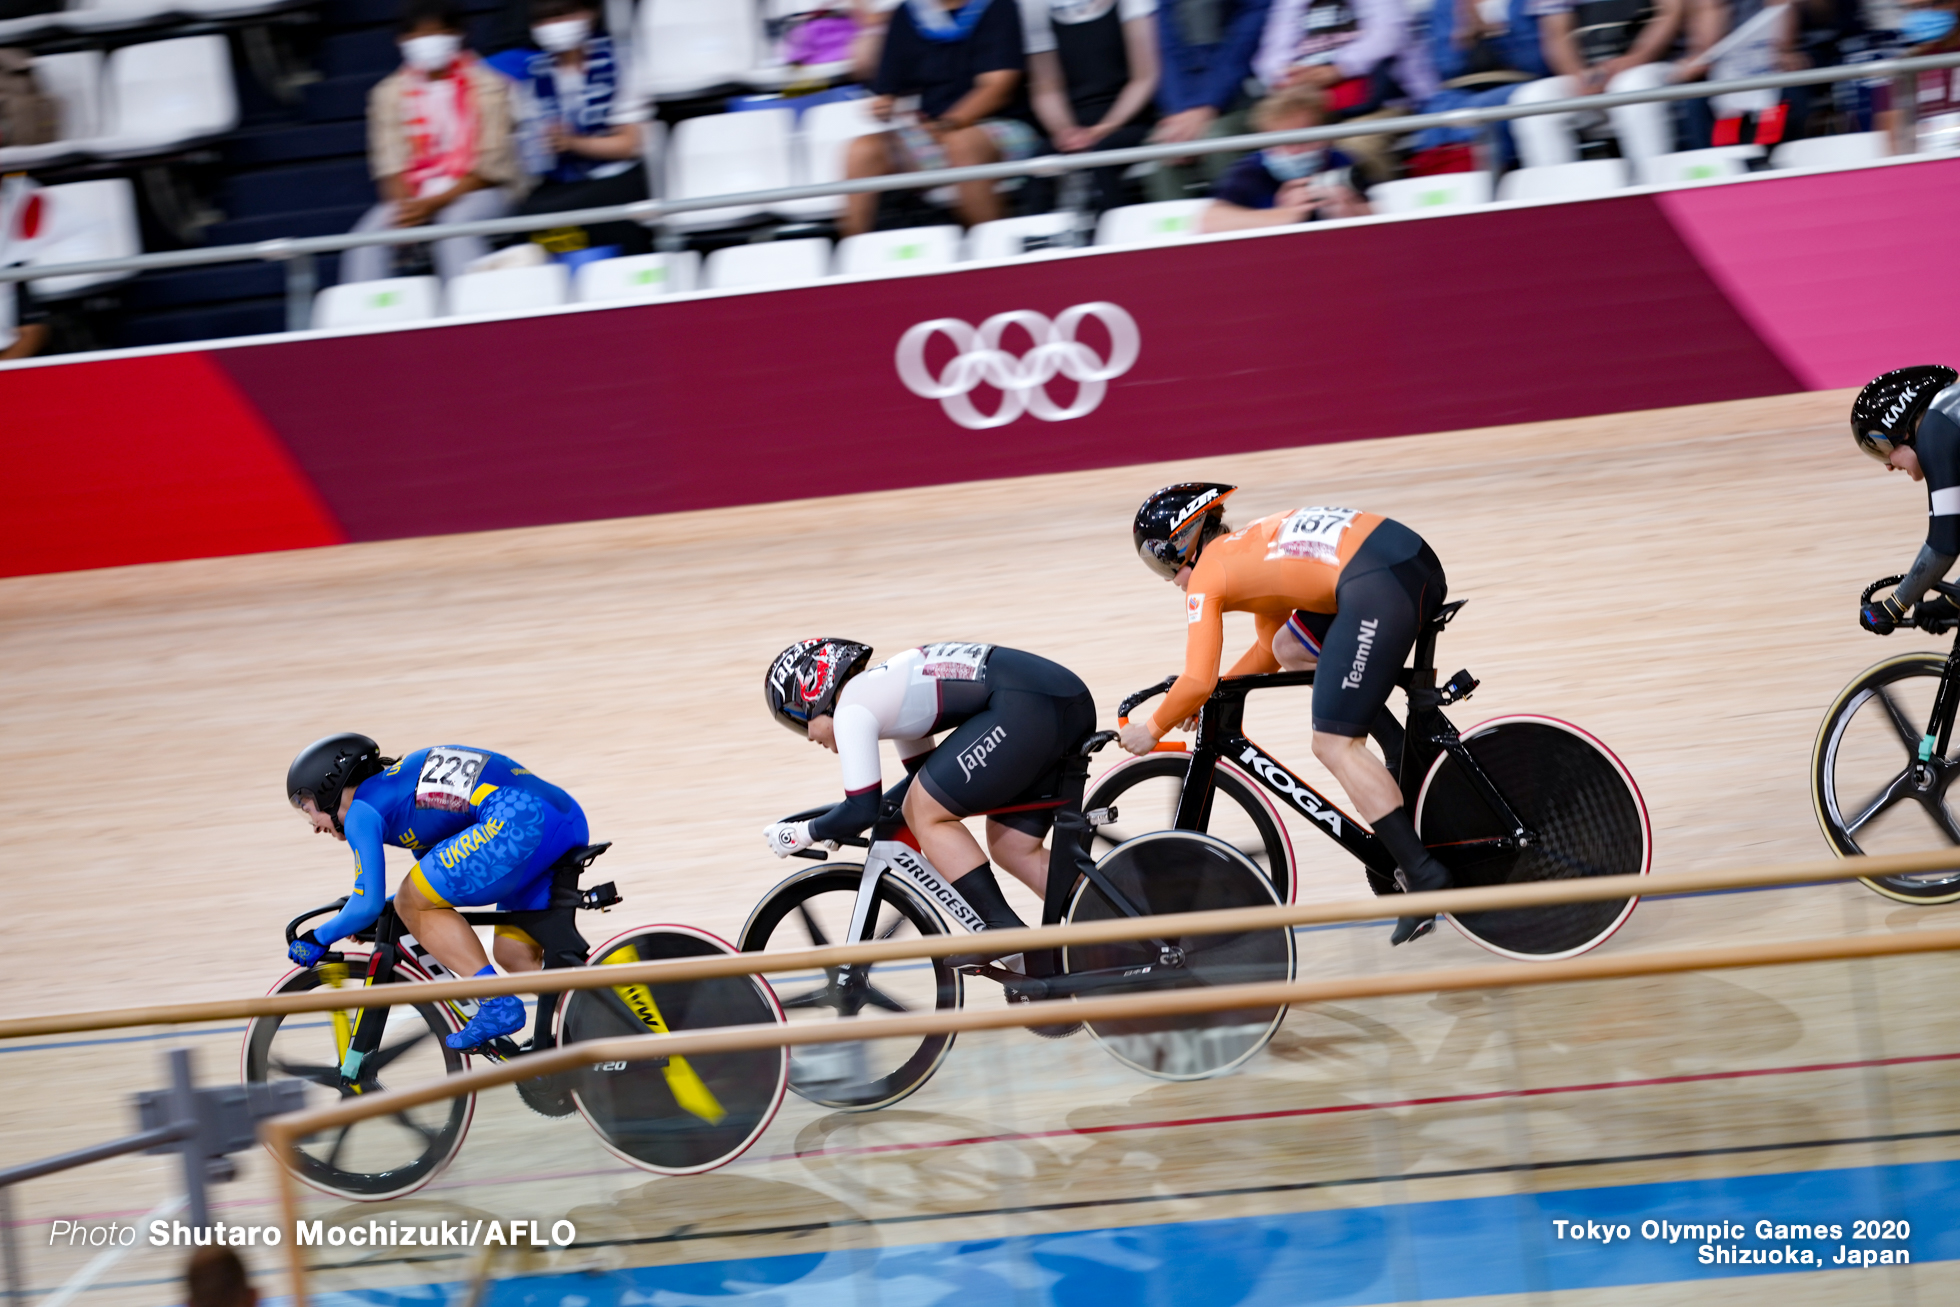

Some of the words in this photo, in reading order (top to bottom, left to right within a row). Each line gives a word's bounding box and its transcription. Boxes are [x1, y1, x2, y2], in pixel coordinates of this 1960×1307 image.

[1881, 386, 1918, 429] KASK
[1169, 488, 1219, 532] LAZER
[1292, 513, 1346, 535] 187
[771, 639, 818, 703] Japan
[1341, 618, 1379, 690] TeamNL
[421, 753, 482, 789] 229
[956, 722, 1007, 784] Japan
[1239, 747, 1342, 838] KOGA
[439, 816, 505, 869] UKRAINE
